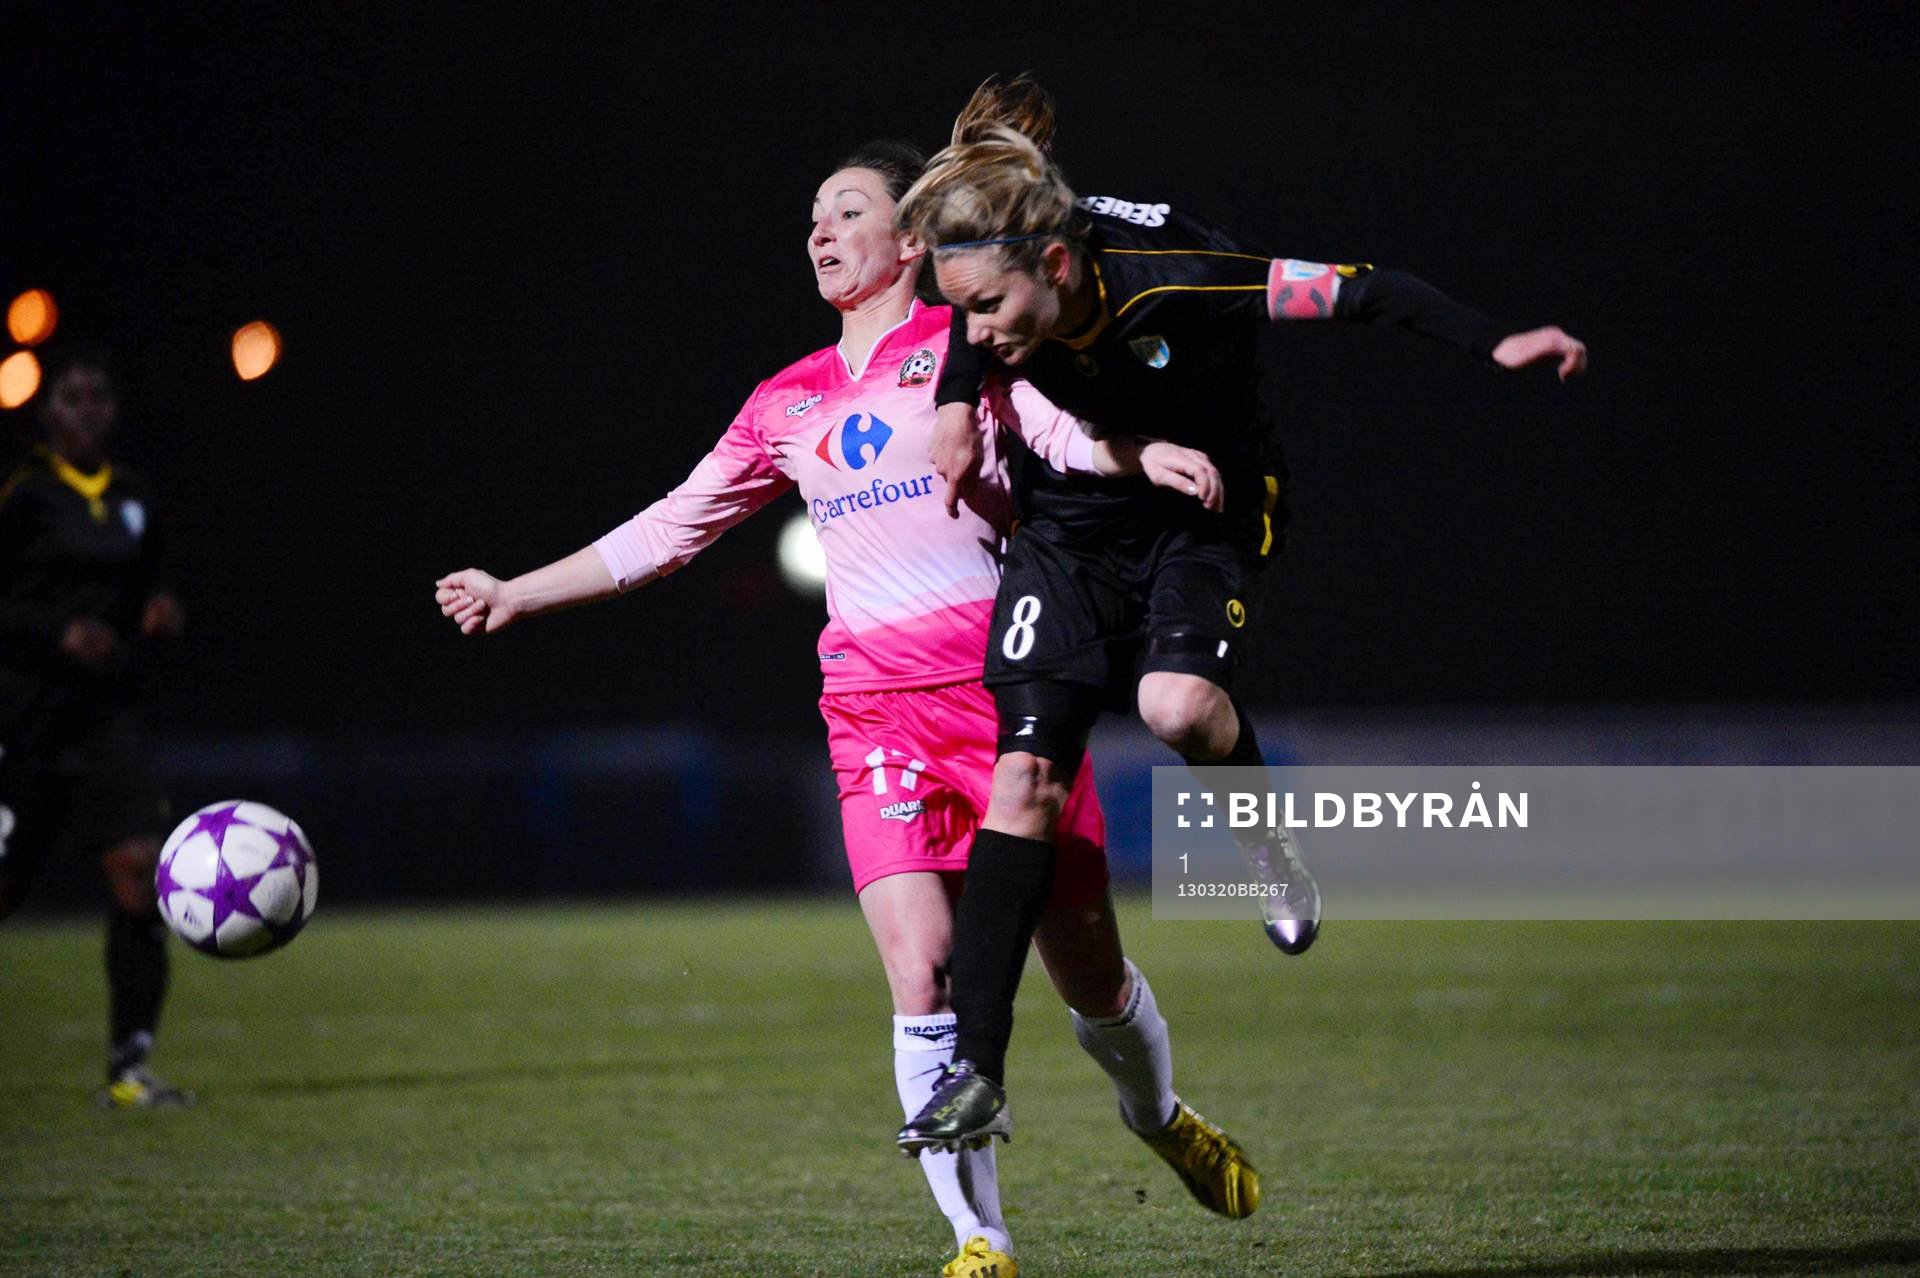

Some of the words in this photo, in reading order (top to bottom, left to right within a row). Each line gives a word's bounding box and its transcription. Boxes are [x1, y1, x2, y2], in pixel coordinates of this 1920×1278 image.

[813, 475, 933, 523] Carrefour
[1002, 594, 1042, 661] 8
[865, 746, 926, 796] 17
